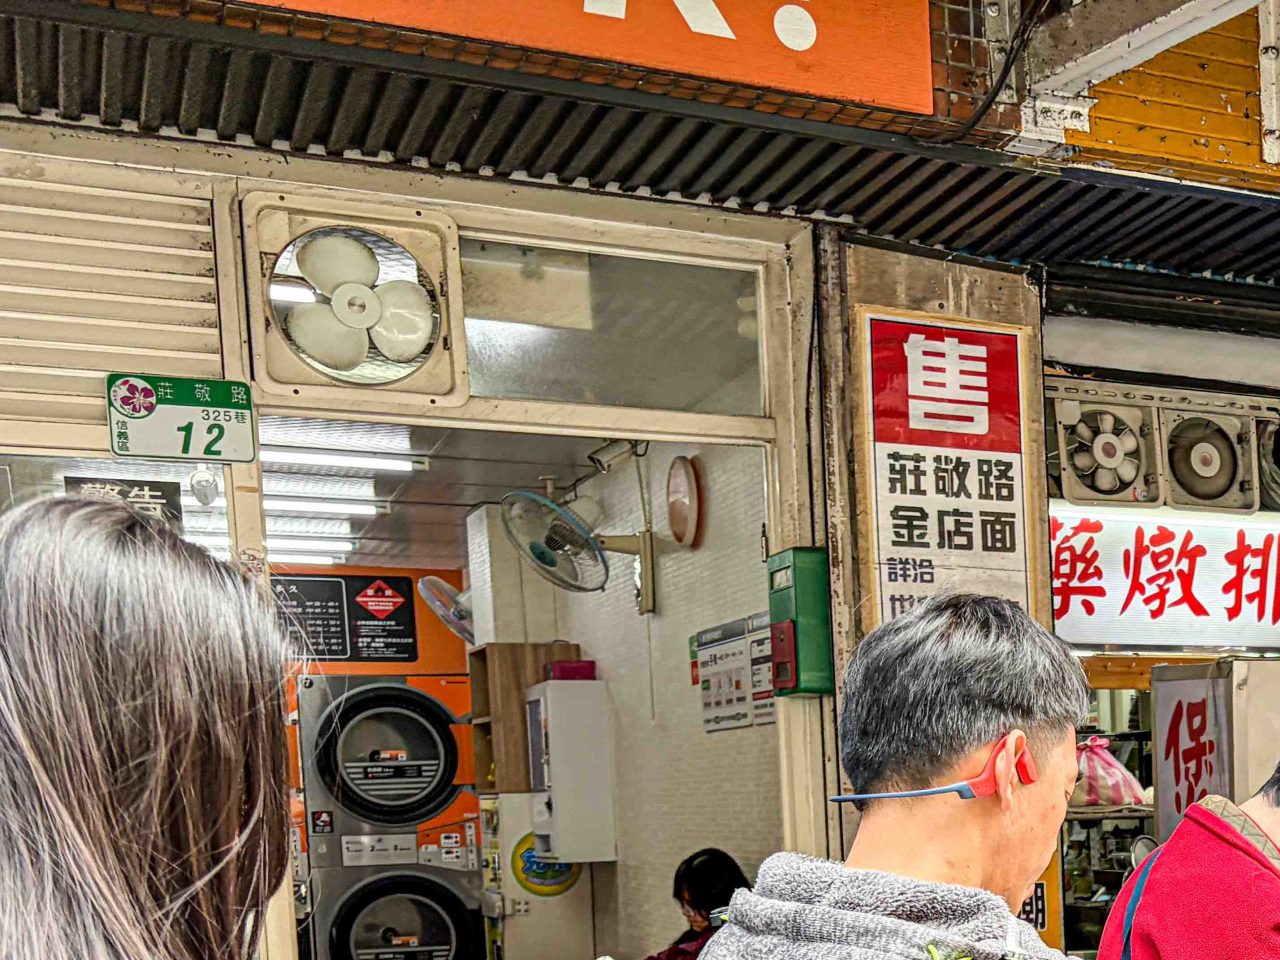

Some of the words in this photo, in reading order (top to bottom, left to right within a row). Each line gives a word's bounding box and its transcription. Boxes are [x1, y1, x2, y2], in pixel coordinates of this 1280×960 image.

[157, 381, 247, 404] 莊敬路
[903, 333, 989, 435] 售
[201, 409, 248, 424] 325巷
[116, 419, 130, 452] 信義區
[177, 421, 226, 456] 12
[887, 451, 1015, 502] 莊敬路
[890, 505, 1017, 553] 金店面
[886, 557, 935, 584] 詳洽
